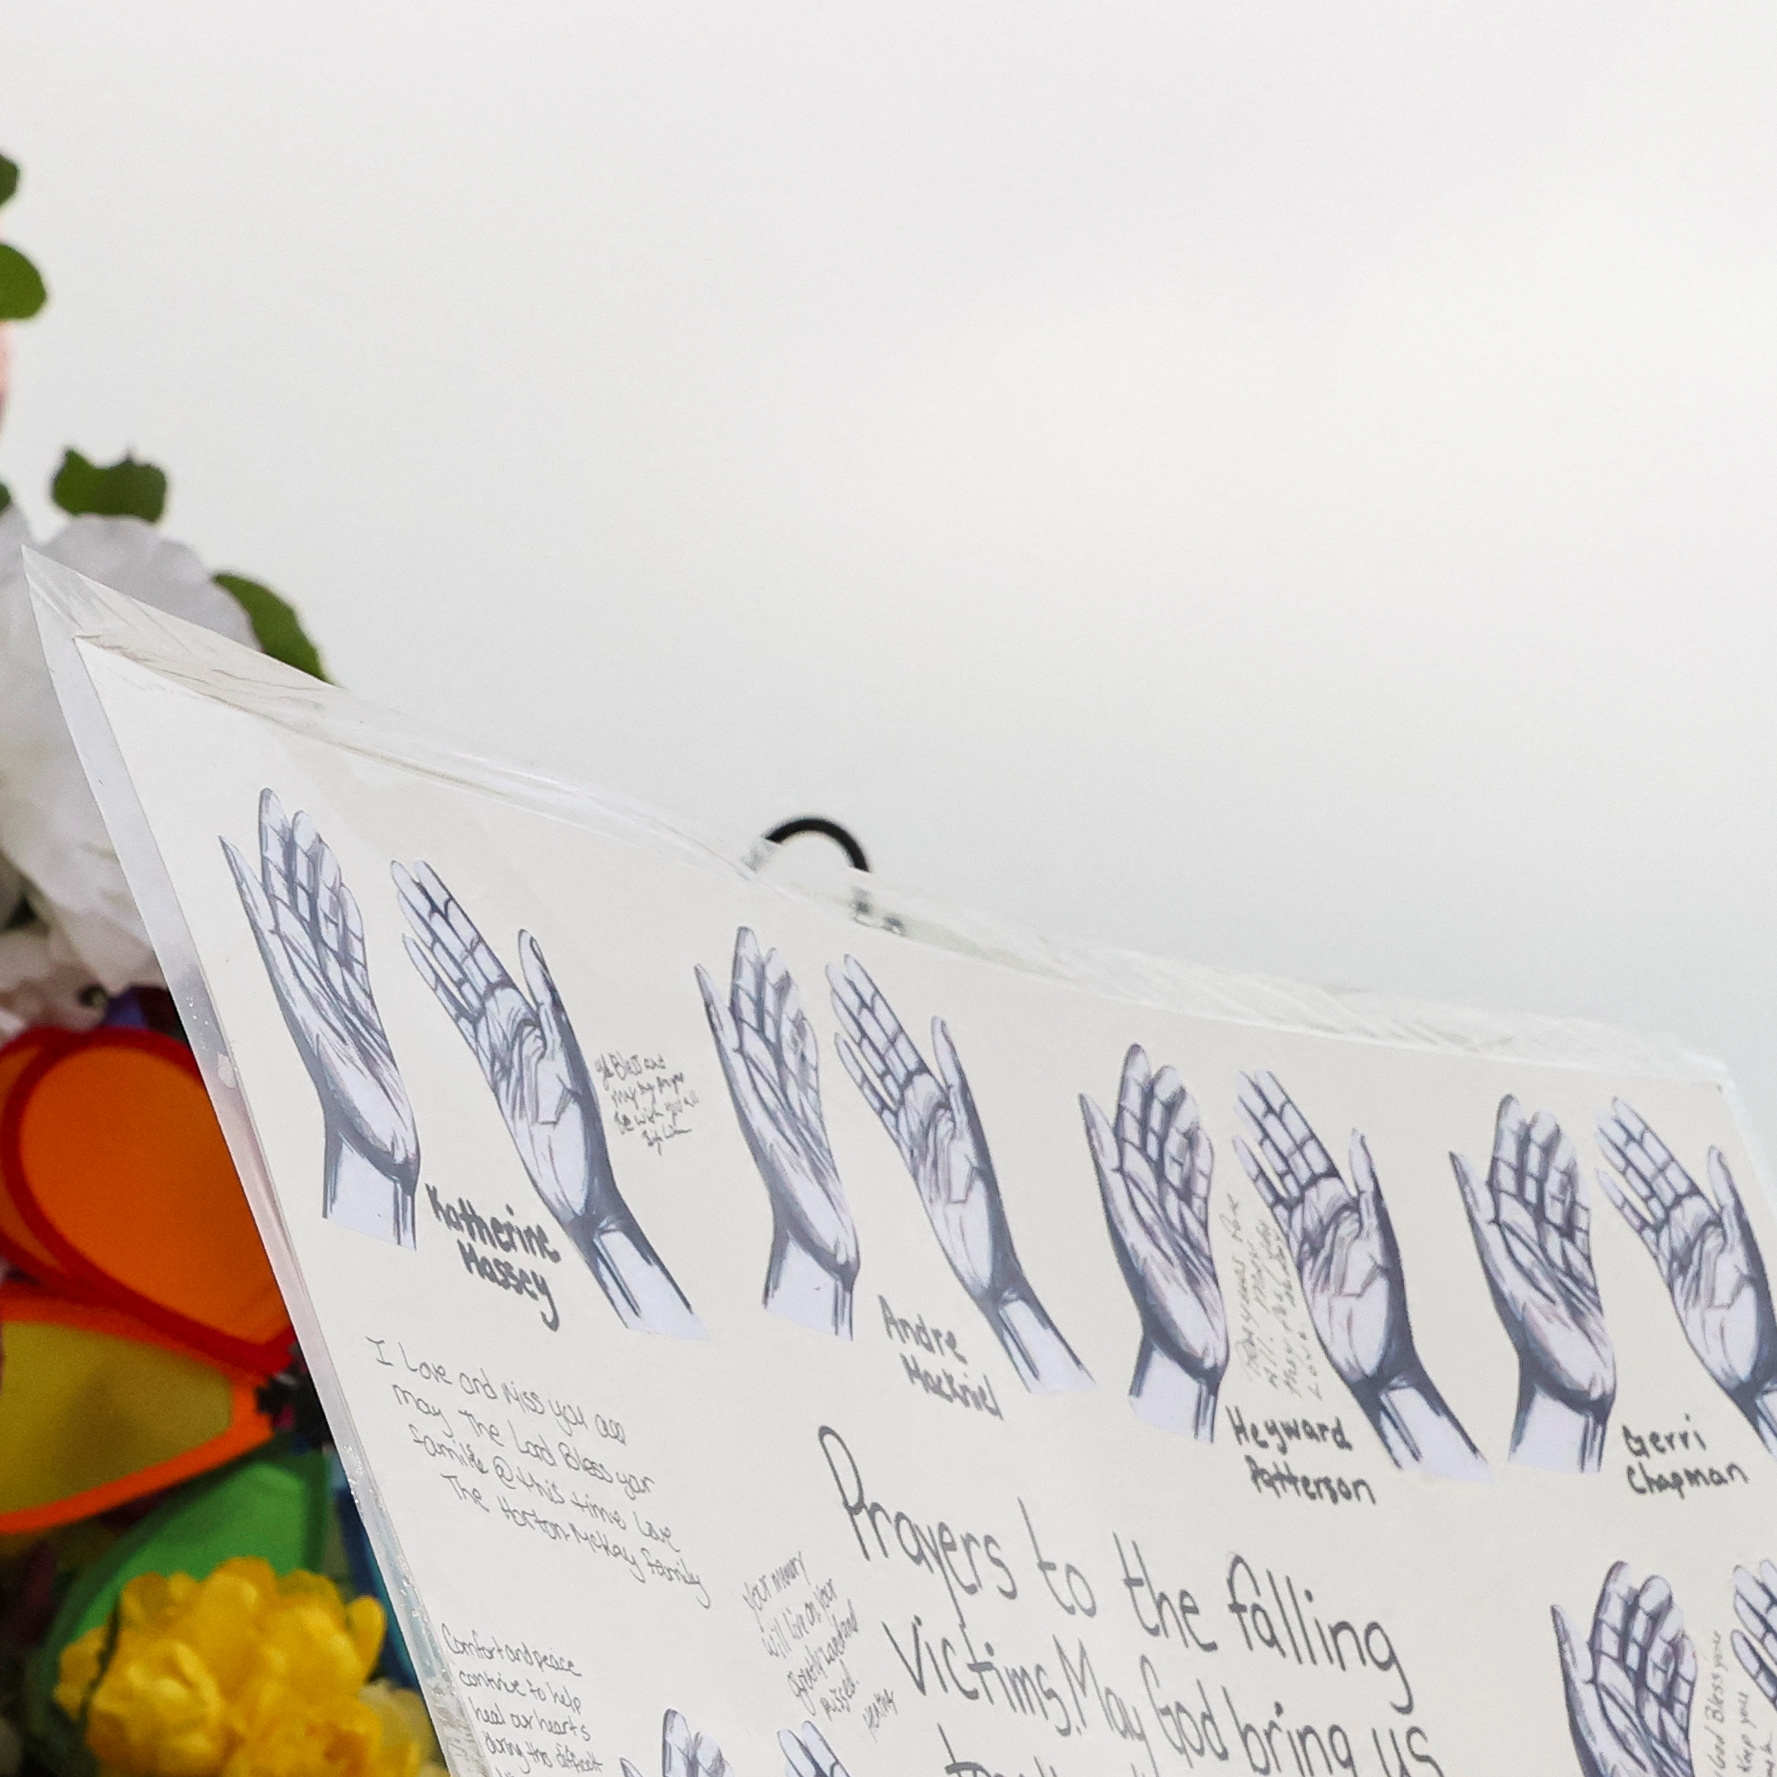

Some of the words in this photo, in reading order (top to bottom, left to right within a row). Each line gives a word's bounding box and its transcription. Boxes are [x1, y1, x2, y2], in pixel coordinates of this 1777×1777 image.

[878, 1294, 968, 1365] Andre
[365, 1336, 393, 1367] I
[459, 1368, 498, 1400] and
[1225, 1404, 1354, 1456] Heyward
[1621, 1412, 1709, 1461] Gerri
[1243, 1453, 1378, 1506] Patterson
[1625, 1460, 1751, 1501] Chapman
[817, 1425, 1018, 1625] Prayers
[1016, 1496, 1098, 1618] to
[1112, 1531, 1218, 1652] the
[1226, 1552, 1415, 1715] falling
[1140, 1654, 1229, 1770] God
